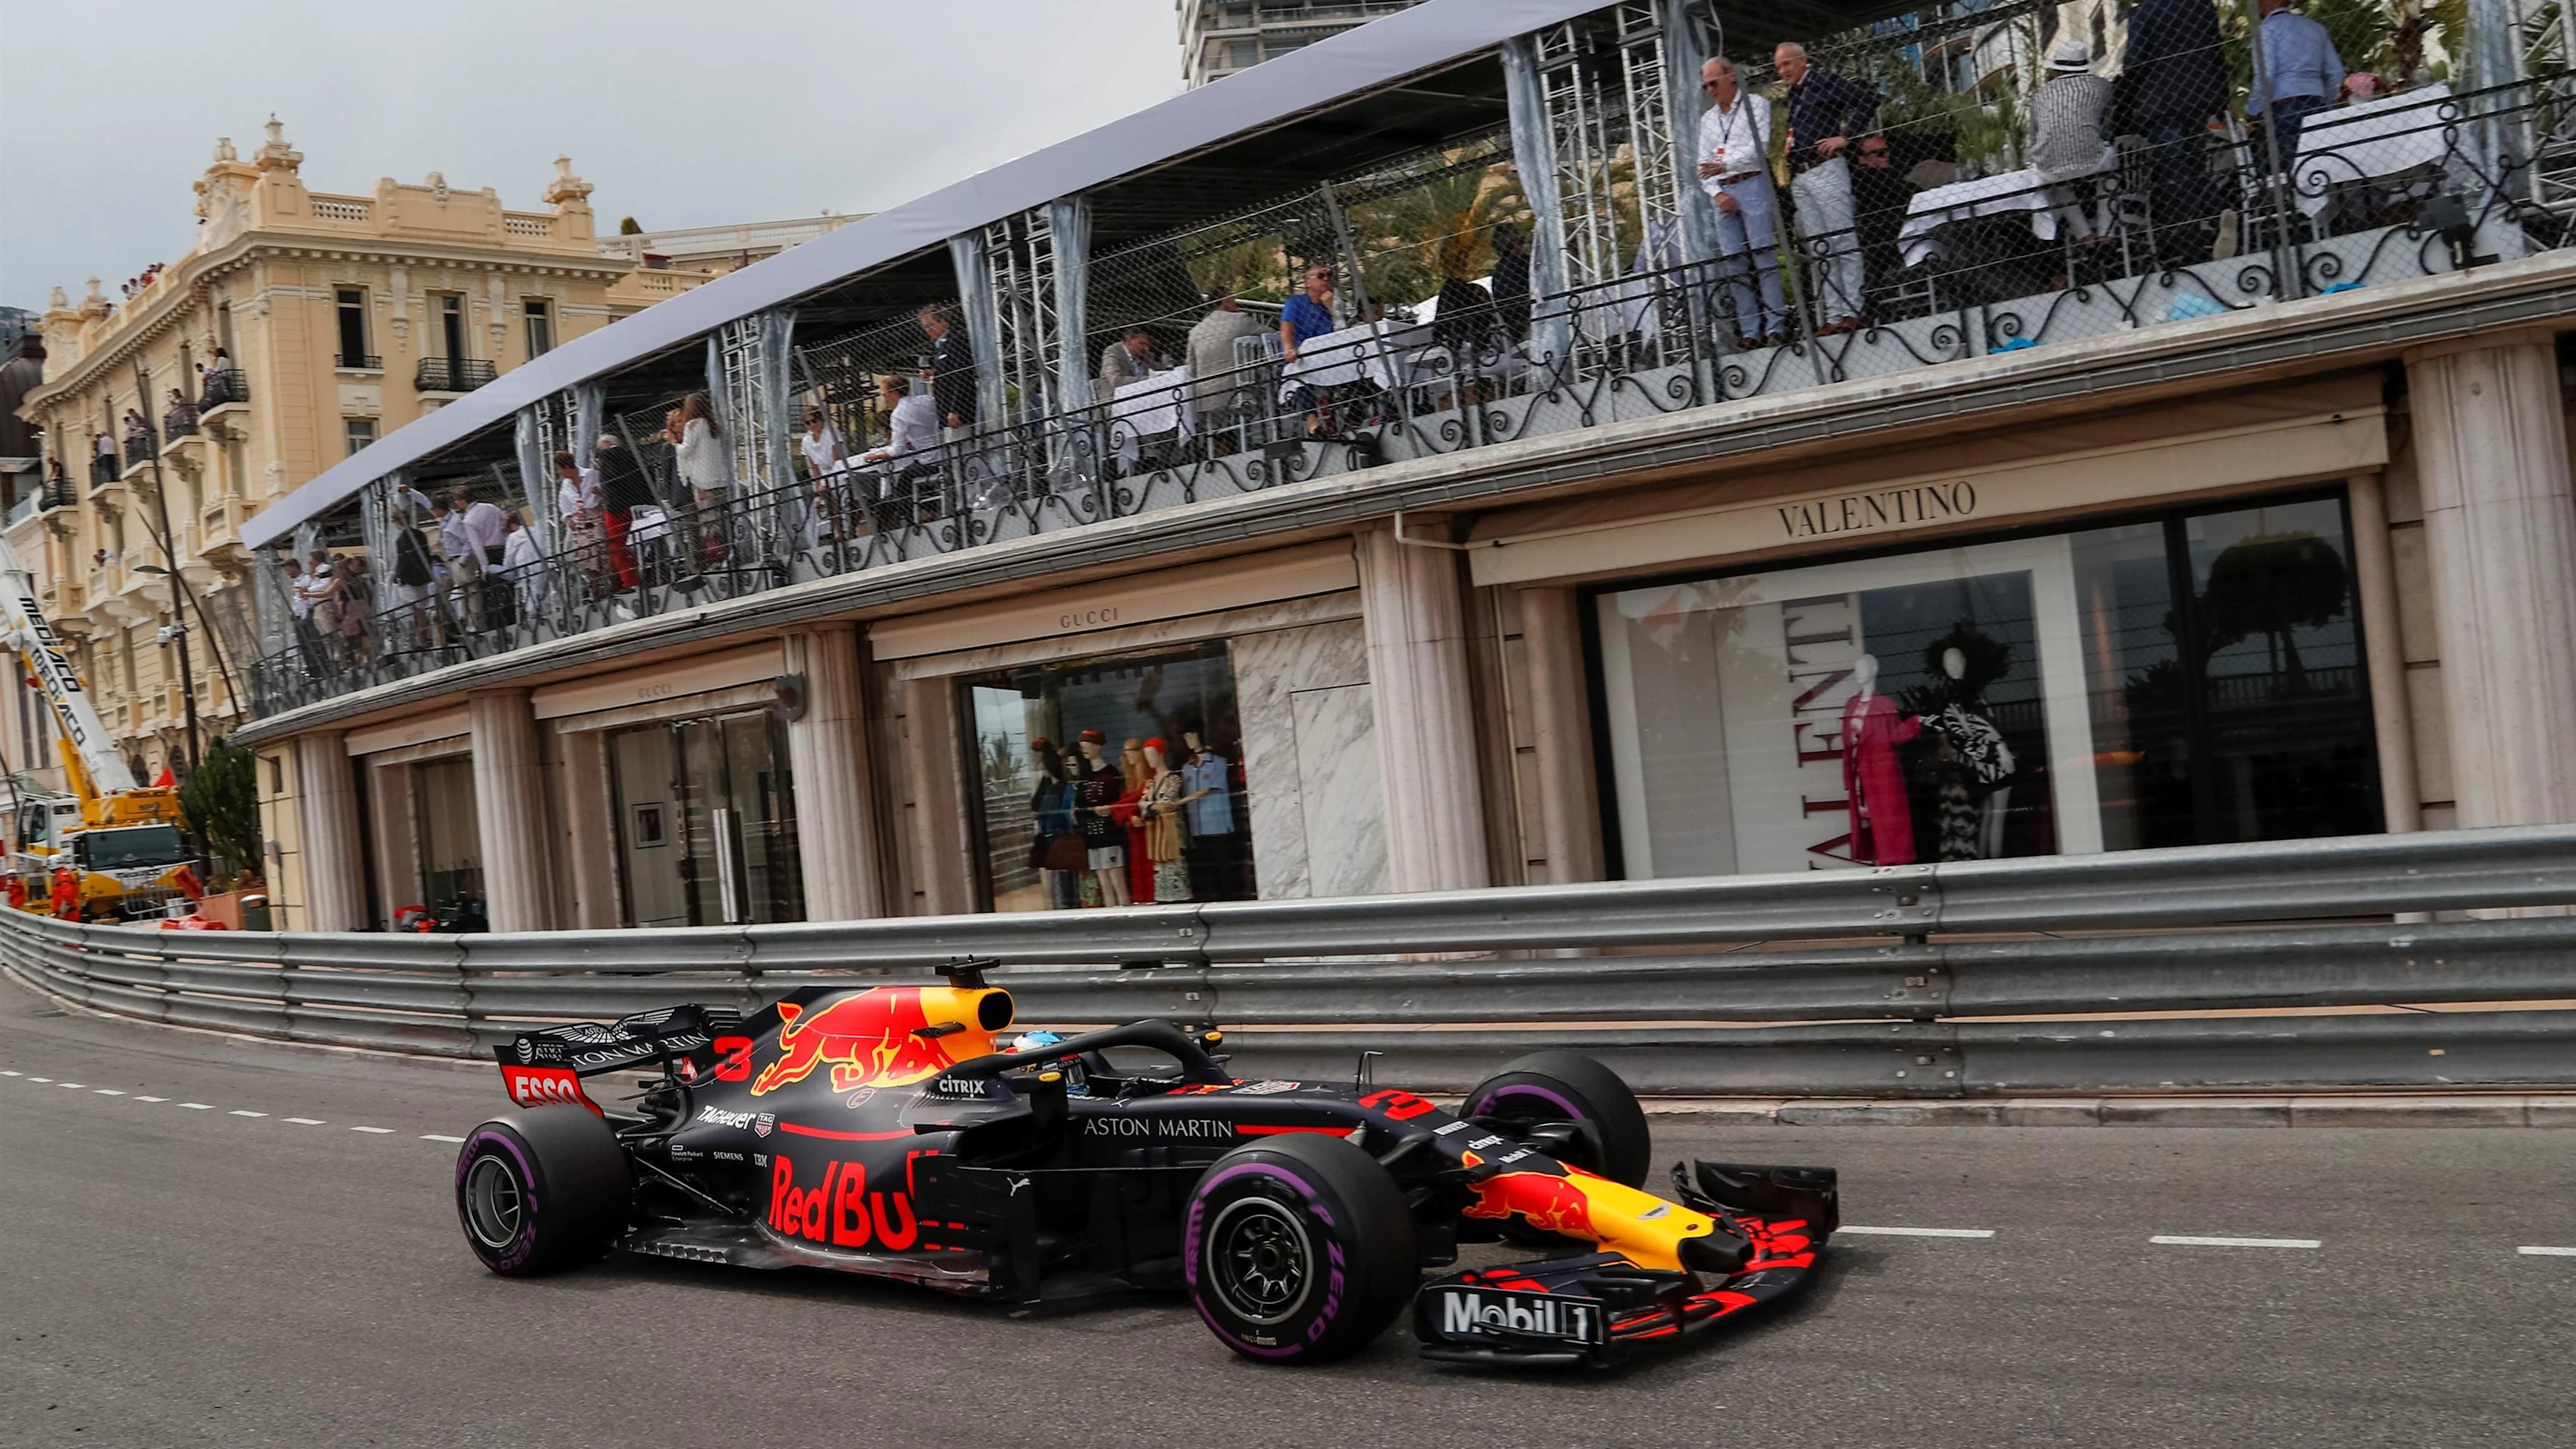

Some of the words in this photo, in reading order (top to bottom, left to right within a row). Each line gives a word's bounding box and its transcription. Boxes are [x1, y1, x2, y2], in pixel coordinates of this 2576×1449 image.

[1779, 480, 1976, 538] VALENTINO
[1060, 608, 1118, 629] GUCCI
[713, 1036, 754, 1082] 3
[1084, 1118, 1150, 1136] ASTON
[1158, 1119, 1233, 1138] MARTIN
[713, 1151, 744, 1161] SIEMENS
[769, 1154, 838, 1242] Red
[833, 1150, 939, 1251] Bu
[1444, 1292, 1557, 1334] Mobil
[1572, 1307, 1588, 1340] 1
